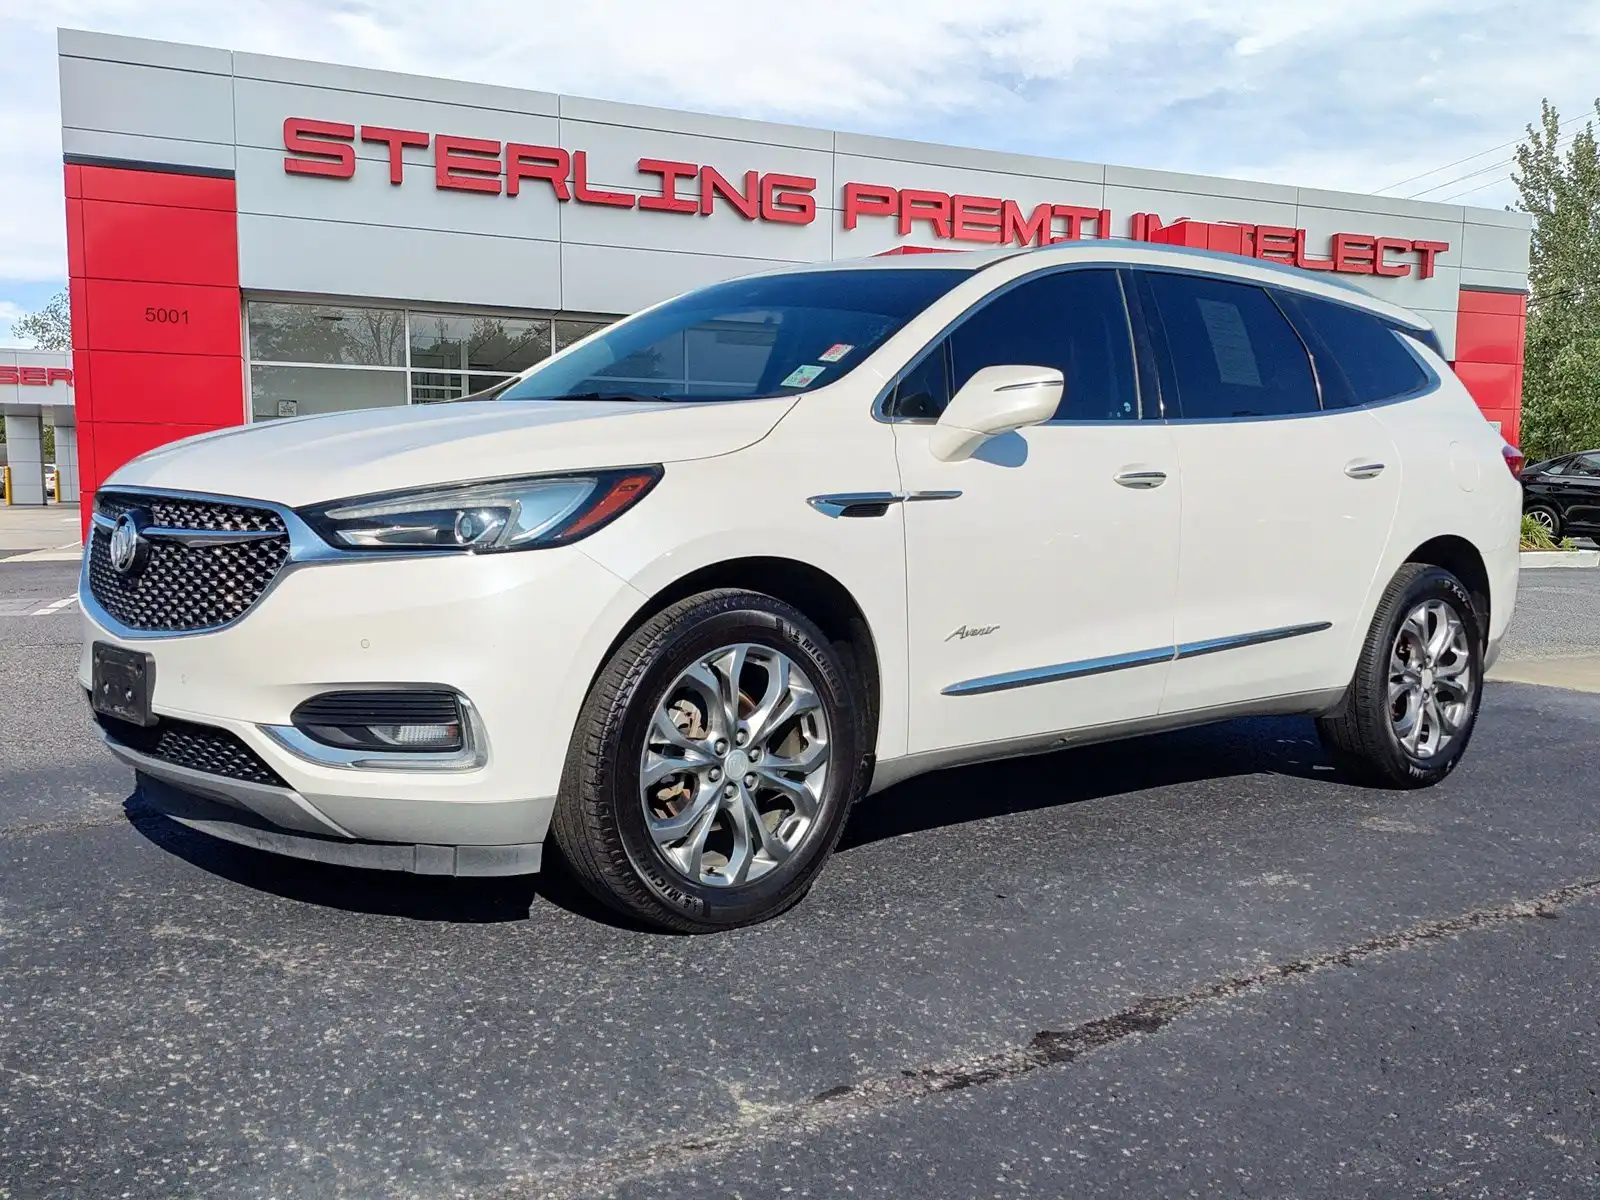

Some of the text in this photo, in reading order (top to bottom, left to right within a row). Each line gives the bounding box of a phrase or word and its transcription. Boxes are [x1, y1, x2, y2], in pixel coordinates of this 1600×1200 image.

[284, 117, 816, 226] STERLING
[1218, 220, 1449, 280] ELECT
[144, 307, 189, 325] 5001
[943, 625, 1001, 643] Avenir
